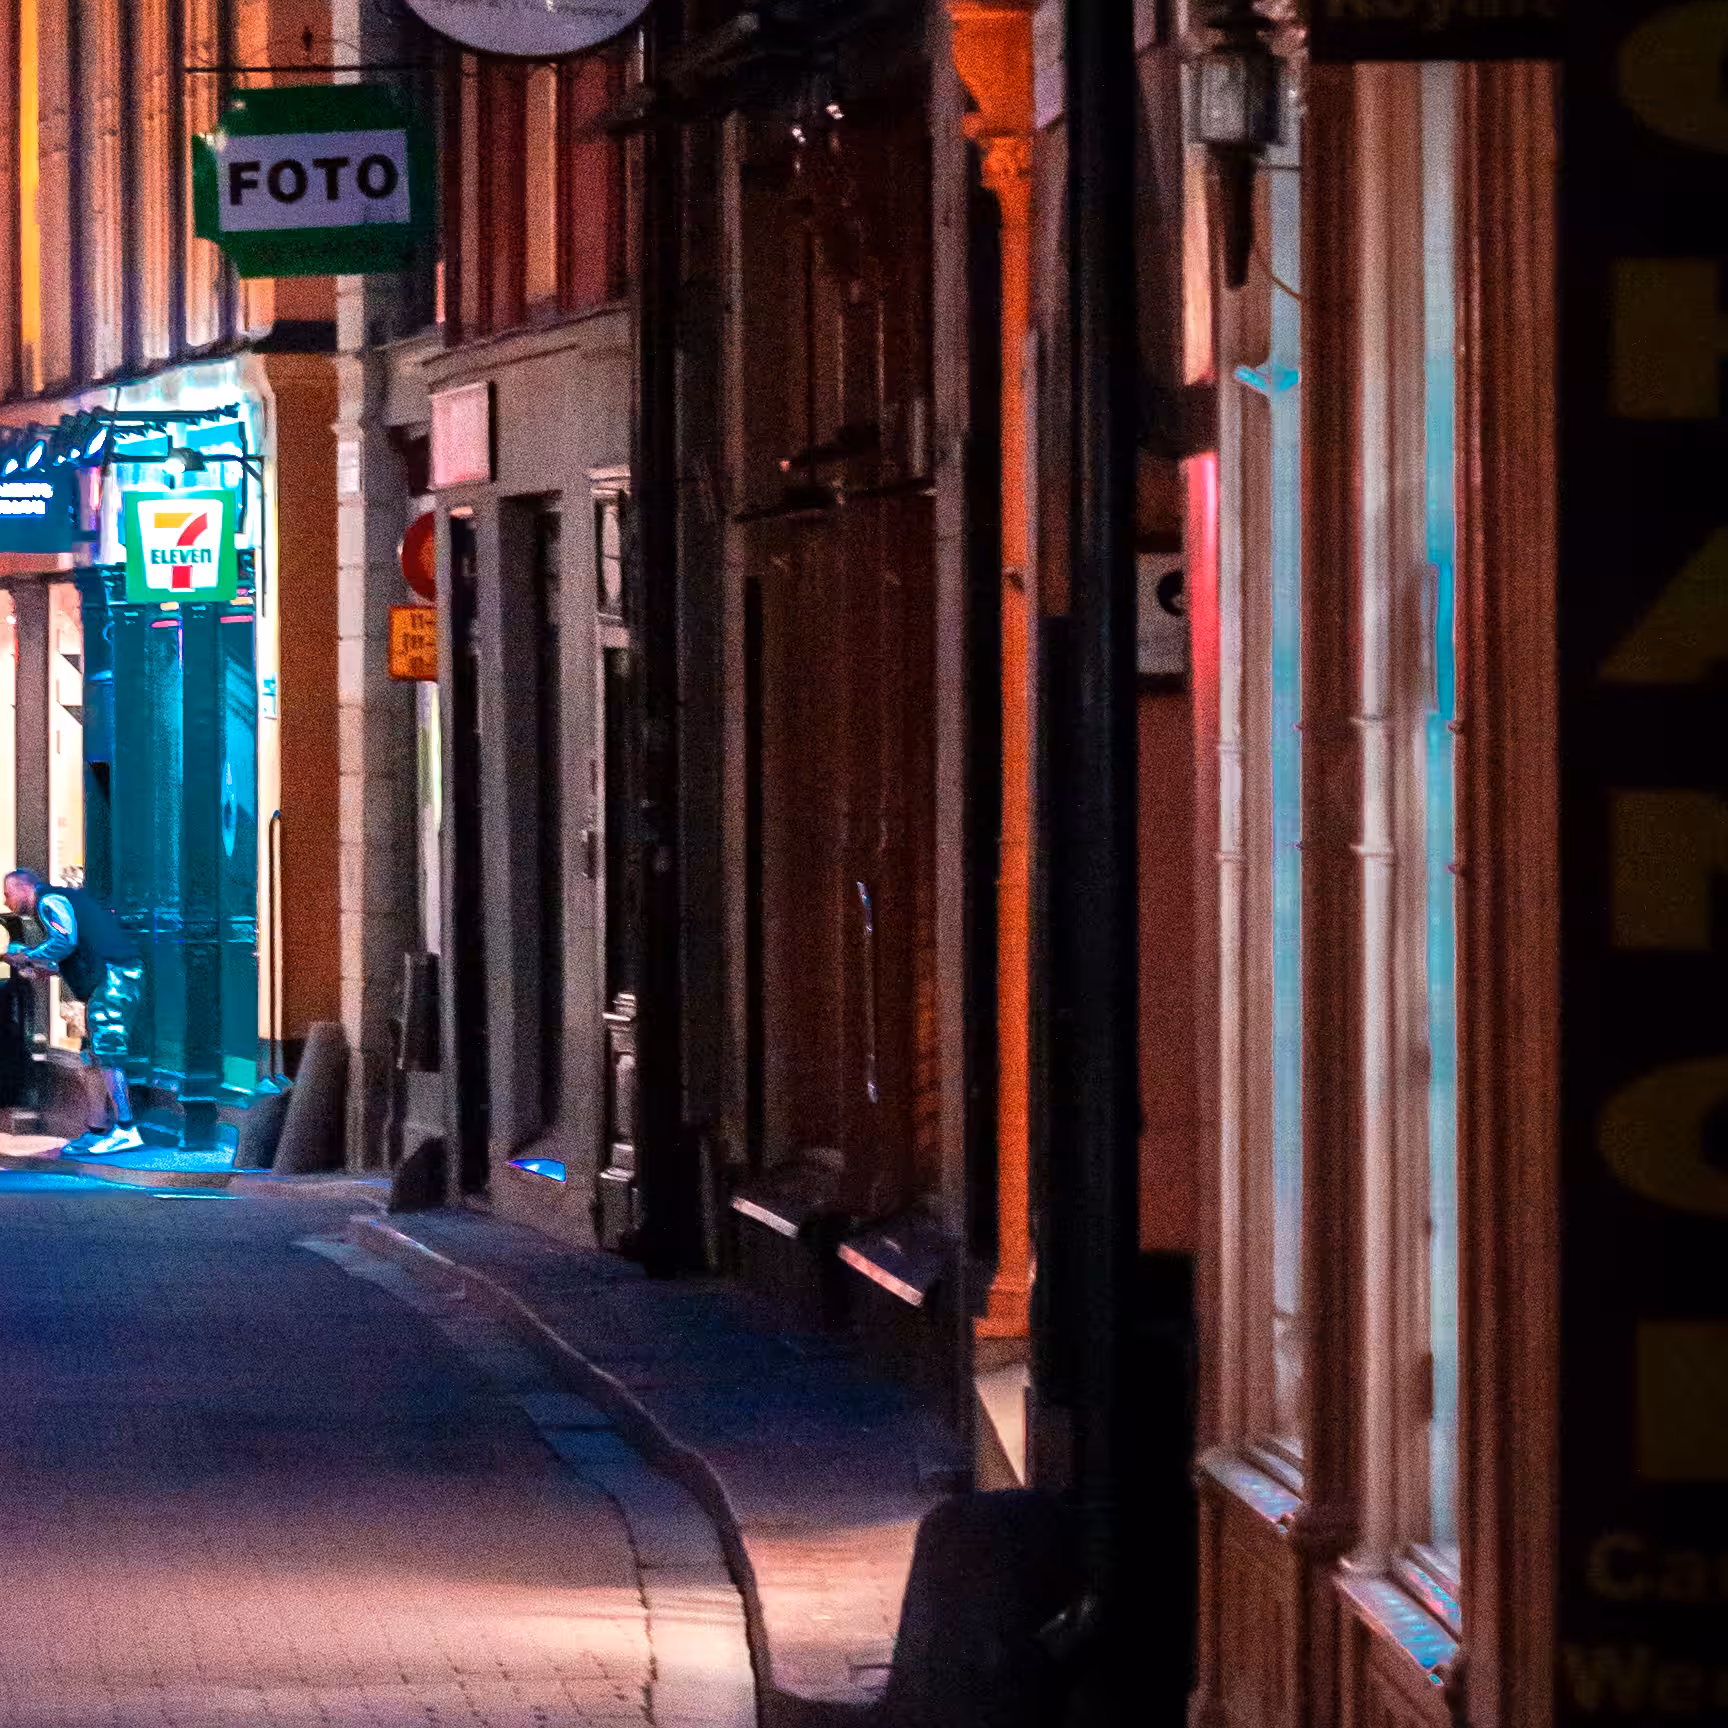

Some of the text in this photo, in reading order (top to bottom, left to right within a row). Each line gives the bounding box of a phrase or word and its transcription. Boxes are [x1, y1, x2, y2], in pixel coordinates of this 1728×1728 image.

[228, 154, 399, 206] FOTO
[1584, 1525, 1728, 1606] Ca
[1555, 1638, 1728, 1714] We
